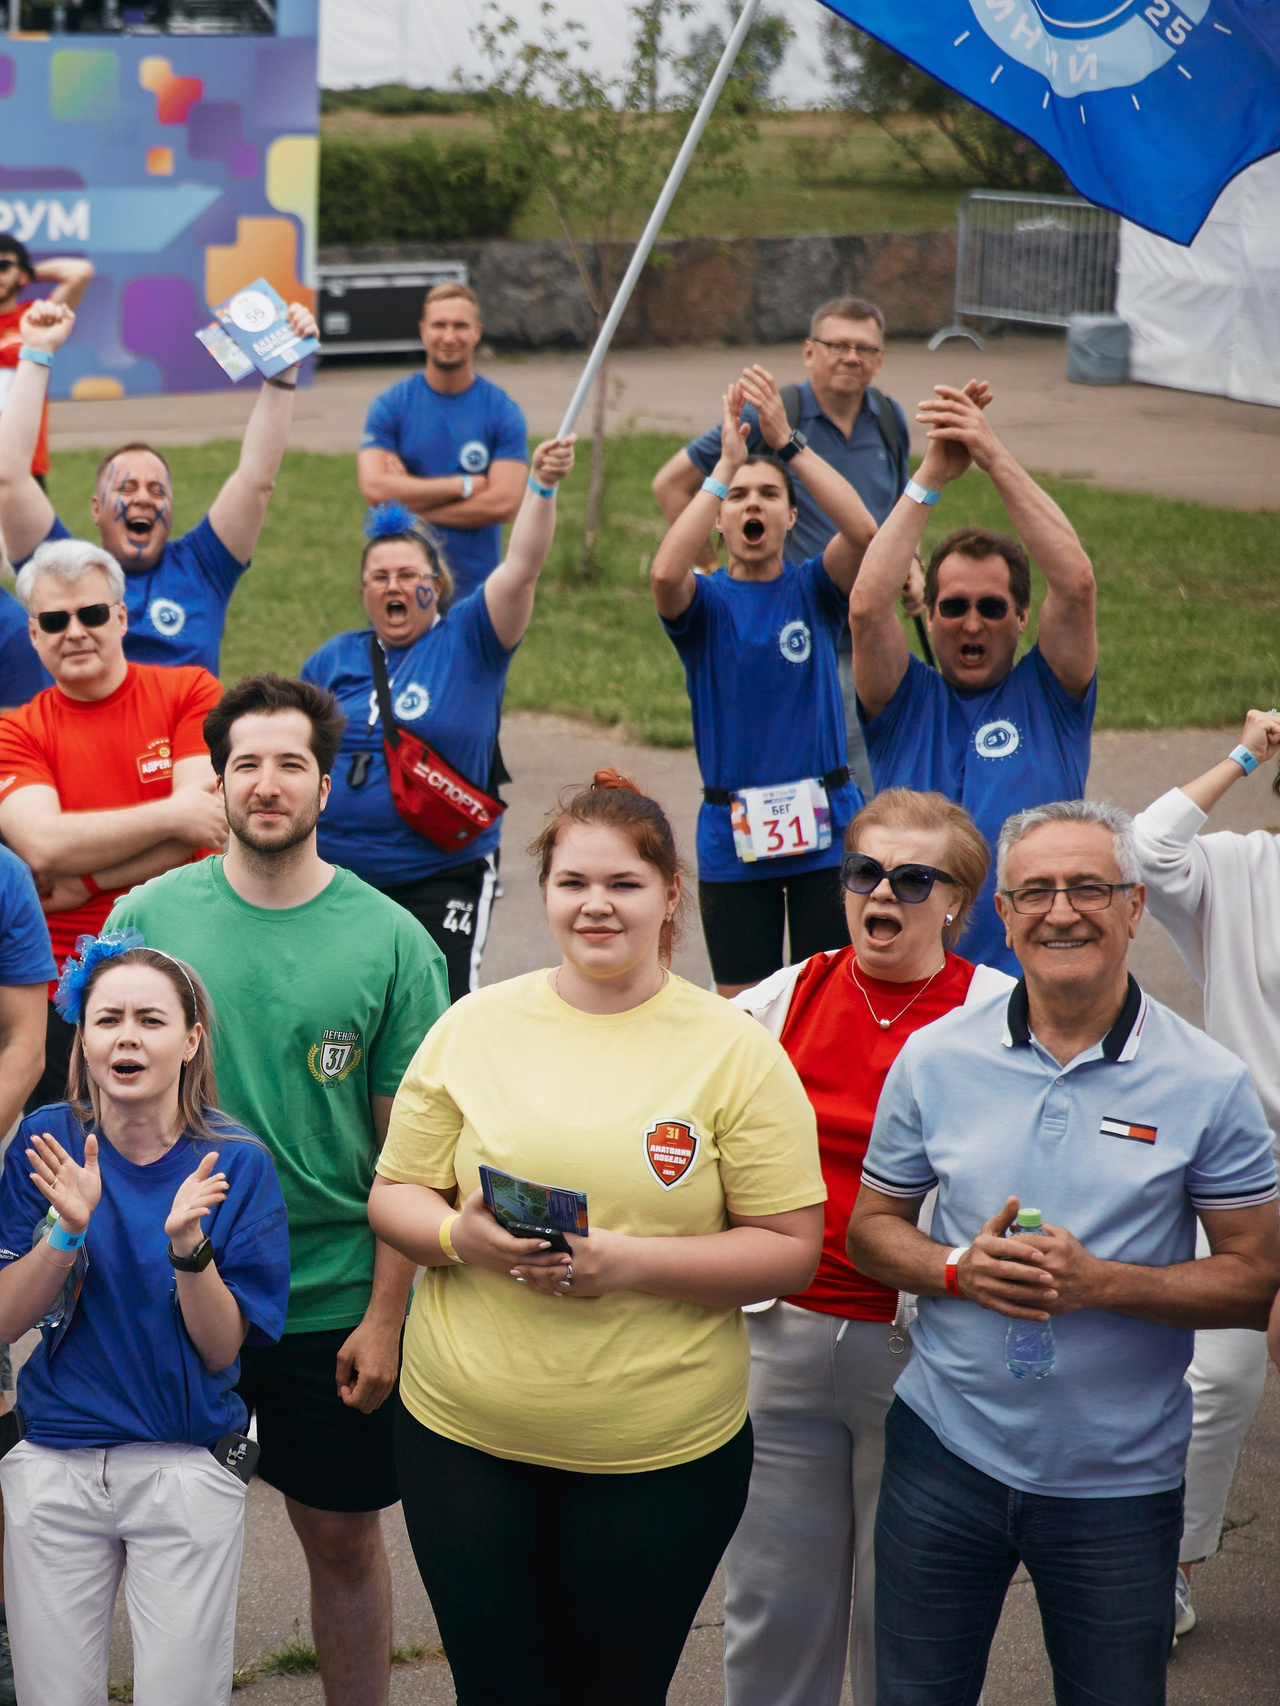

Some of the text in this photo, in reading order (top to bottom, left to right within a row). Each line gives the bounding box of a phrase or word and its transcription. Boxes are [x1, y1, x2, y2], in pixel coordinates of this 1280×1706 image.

[1144, 0, 1192, 45] 25
[790, 635, 805, 648] 31
[987, 732, 1006, 746] 31
[771, 804, 791, 816] БЕГ
[763, 816, 809, 852] 31
[443, 910, 472, 936] 44
[322, 1029, 359, 1041] ЛЕГЕНДЫ
[325, 1048, 346, 1070] 31
[666, 1126, 680, 1140] 31
[650, 1145, 691, 1158] АНАТОМИЯ
[653, 1153, 686, 1165] ПОБЕДЫ
